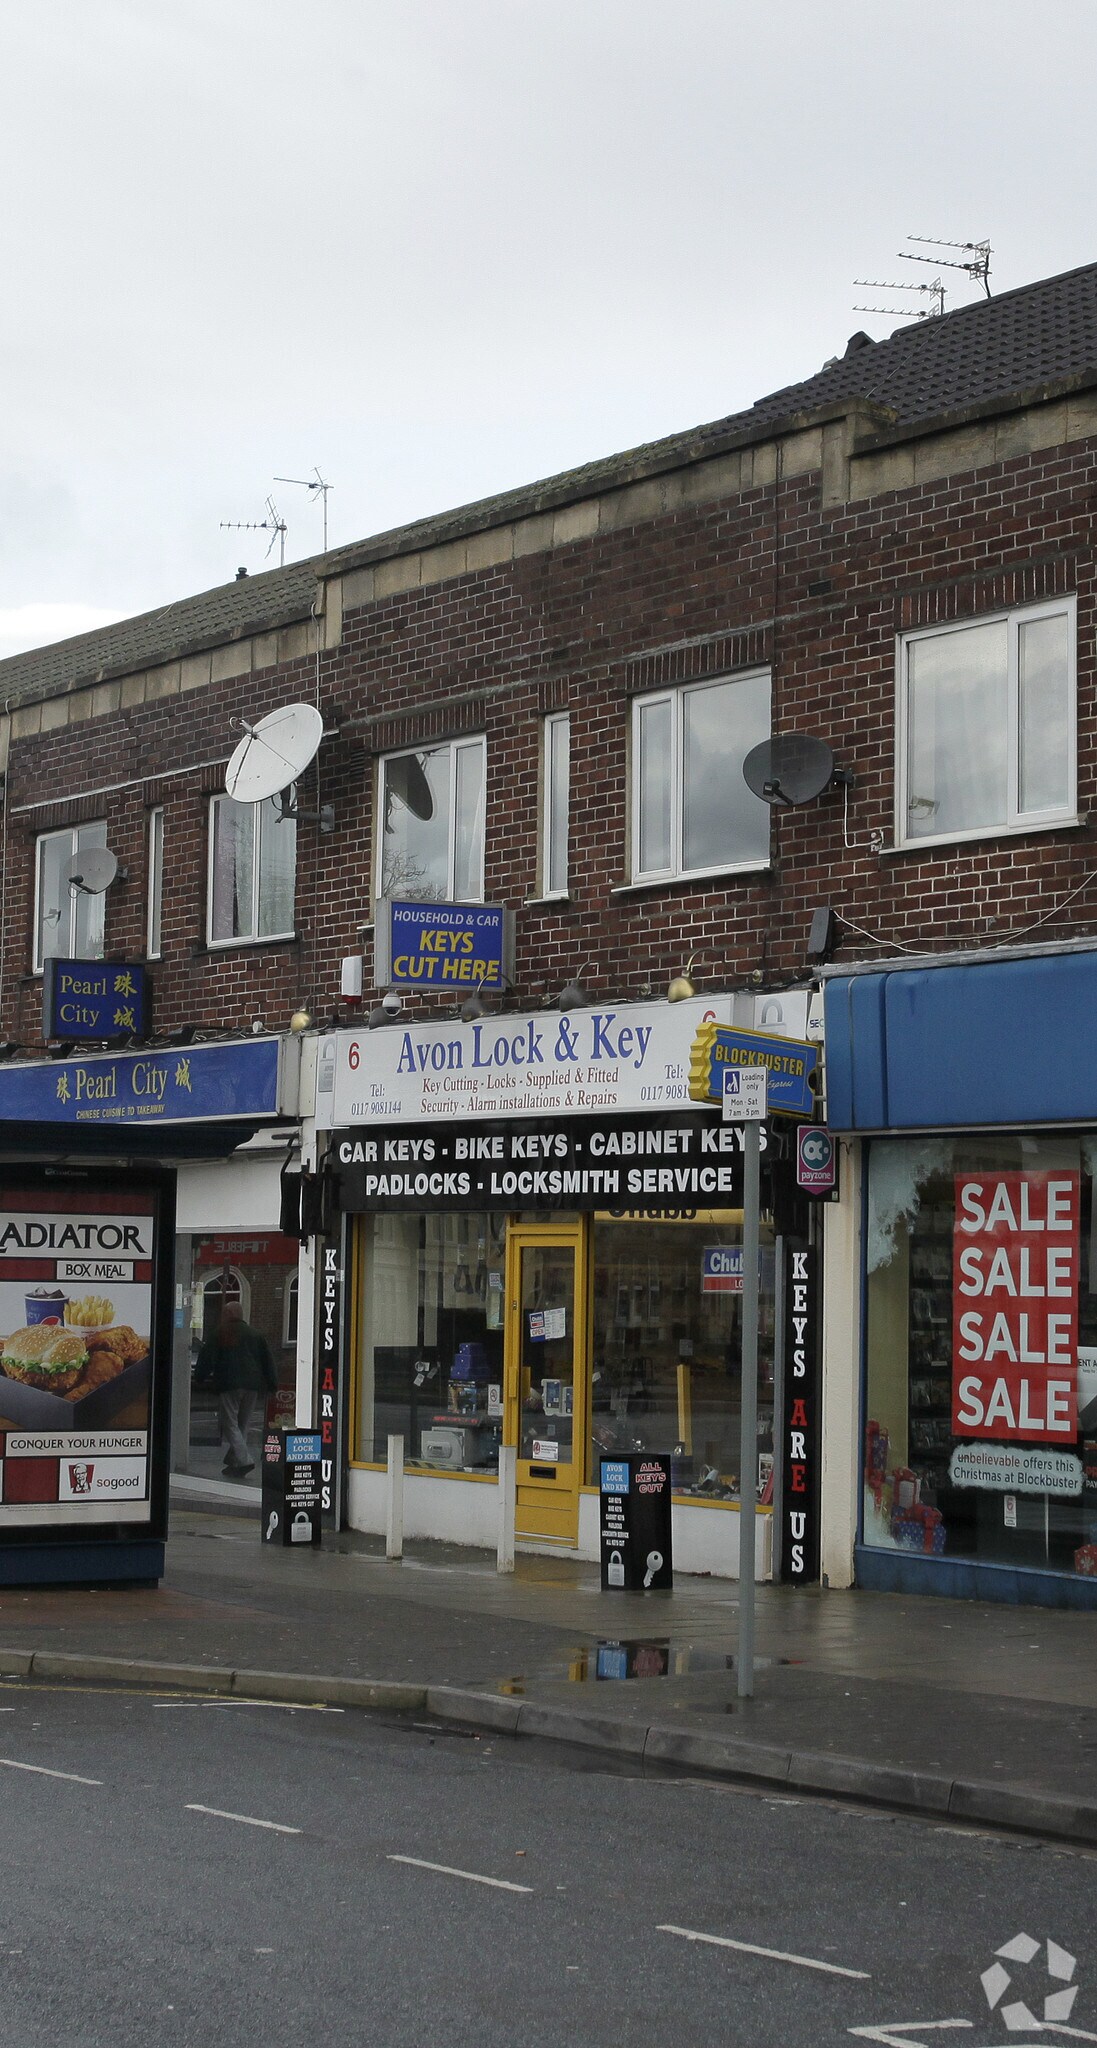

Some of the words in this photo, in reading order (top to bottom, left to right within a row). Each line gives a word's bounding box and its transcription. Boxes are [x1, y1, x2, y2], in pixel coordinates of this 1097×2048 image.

[394, 910, 464, 925] HOUSEHOLD
[465, 914, 474, 925] &
[476, 915, 499, 926] CAR
[419, 930, 474, 953] KEYS
[393, 956, 439, 978] CUT
[442, 958, 500, 981] HERE
[60, 975, 107, 996] Pearl
[60, 1003, 100, 1027] City
[397, 1032, 463, 1073] Avon
[471, 1020, 544, 1067] Lock
[555, 1016, 579, 1062] &
[591, 1014, 653, 1069] Key
[349, 1042, 360, 1070] 6
[715, 1044, 804, 1076] BLOCKBUSTER
[75, 1066, 117, 1100] Pearl
[132, 1062, 168, 1100] City
[422, 1078, 441, 1095] Key
[443, 1075, 478, 1093] Cutting
[486, 1073, 516, 1090] Locks
[525, 1069, 571, 1090] Supplied
[574, 1067, 584, 1084] &
[587, 1067, 619, 1083] Fitted
[664, 1064, 683, 1079] Tel:
[741, 1073, 764, 1082] Loading
[370, 1084, 385, 1097] Tel:
[640, 1085, 663, 1100] 0117
[665, 1084, 690, 1099] 9081
[746, 1083, 760, 1091] only
[76, 1109, 100, 1120] CHINESE
[102, 1107, 125, 1118] CUISINE
[137, 1104, 165, 1115] TAKEAWAY
[352, 1102, 369, 1116] 0117
[370, 1100, 402, 1115] 9081144
[420, 1098, 459, 1116] Security
[467, 1096, 496, 1112] Alarm
[499, 1093, 561, 1110] installations
[564, 1090, 574, 1107] &
[577, 1089, 617, 1109] Repairs
[730, 1098, 743, 1106] Mon
[339, 1141, 378, 1163] CAR
[384, 1139, 436, 1162] KEYS
[455, 1136, 504, 1160] BIKE
[511, 1134, 568, 1158] KEYS
[589, 1129, 693, 1156] CABINET
[701, 1126, 768, 1152] KEYS
[366, 1172, 470, 1196] PADLOCKS
[490, 1169, 619, 1195] LOCKSMITH
[627, 1167, 733, 1194] SERVICE
[801, 1170, 831, 1183] payzone
[960, 1181, 1073, 1233] SALE
[0, 1222, 147, 1253] ADIATOR
[65, 1263, 91, 1277] BOX
[95, 1264, 126, 1279] MEAL
[958, 1246, 1072, 1298] SALE
[324, 1249, 336, 1350] KEYS
[792, 1253, 808, 1377] KEYS
[958, 1311, 1071, 1364] SALE
[1078, 1359, 1091, 1367] ENT
[322, 1368, 334, 1443] ARE
[957, 1376, 1071, 1432] SALE
[10, 1439, 64, 1450] CONQUER
[67, 1438, 96, 1449] YOUR
[99, 1438, 143, 1448] HUNGER
[790, 1399, 807, 1492] ARE
[606, 1464, 623, 1472] AVON
[640, 1462, 662, 1472] ALL
[957, 1452, 1020, 1468] unbelievable
[1023, 1457, 1053, 1470] offers
[1056, 1459, 1074, 1473] this
[96, 1476, 139, 1490] sogood
[321, 1459, 333, 1509] US
[606, 1474, 623, 1482] LOCK
[635, 1472, 666, 1483] KEYS
[639, 1483, 663, 1493] CUT
[953, 1467, 1001, 1482] Christmas
[1004, 1472, 1014, 1483] at
[1017, 1472, 1078, 1489] Blockbuster
[790, 1511, 806, 1573] US
